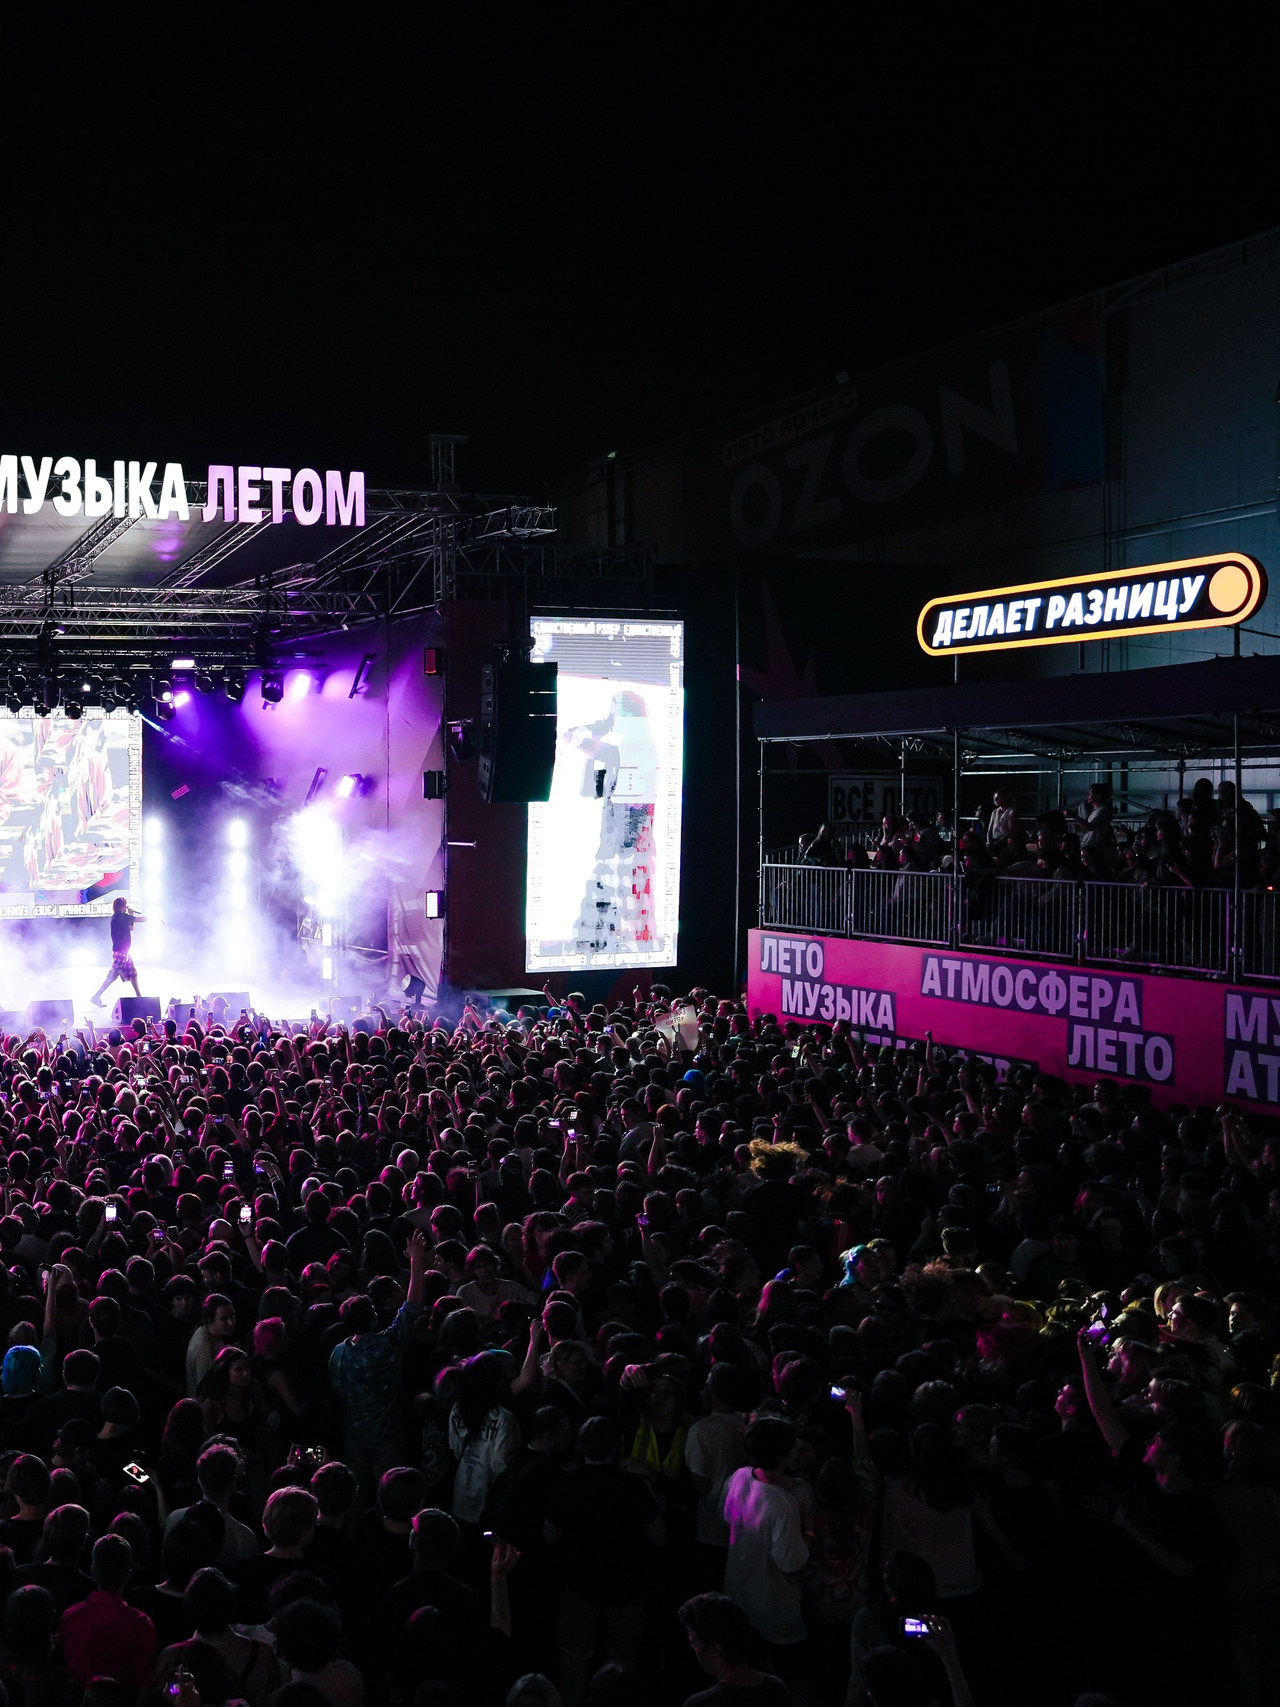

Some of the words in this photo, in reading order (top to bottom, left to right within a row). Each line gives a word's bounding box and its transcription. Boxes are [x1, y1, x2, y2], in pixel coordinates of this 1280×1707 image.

[729, 360, 1018, 549] OZON
[201, 464, 366, 527] ЛЕТОМ
[931, 597, 1042, 648] ДЕЛАЕТ
[1045, 574, 1206, 630] РАЗНИЦУ
[833, 781, 875, 821] ВСЁ
[760, 937, 824, 978] ЛЕТО
[781, 979, 895, 1032] МУЗЫКА
[921, 956, 1141, 1026] АТМОСФЕРА
[1068, 1024, 1173, 1082] ЛЕТО
